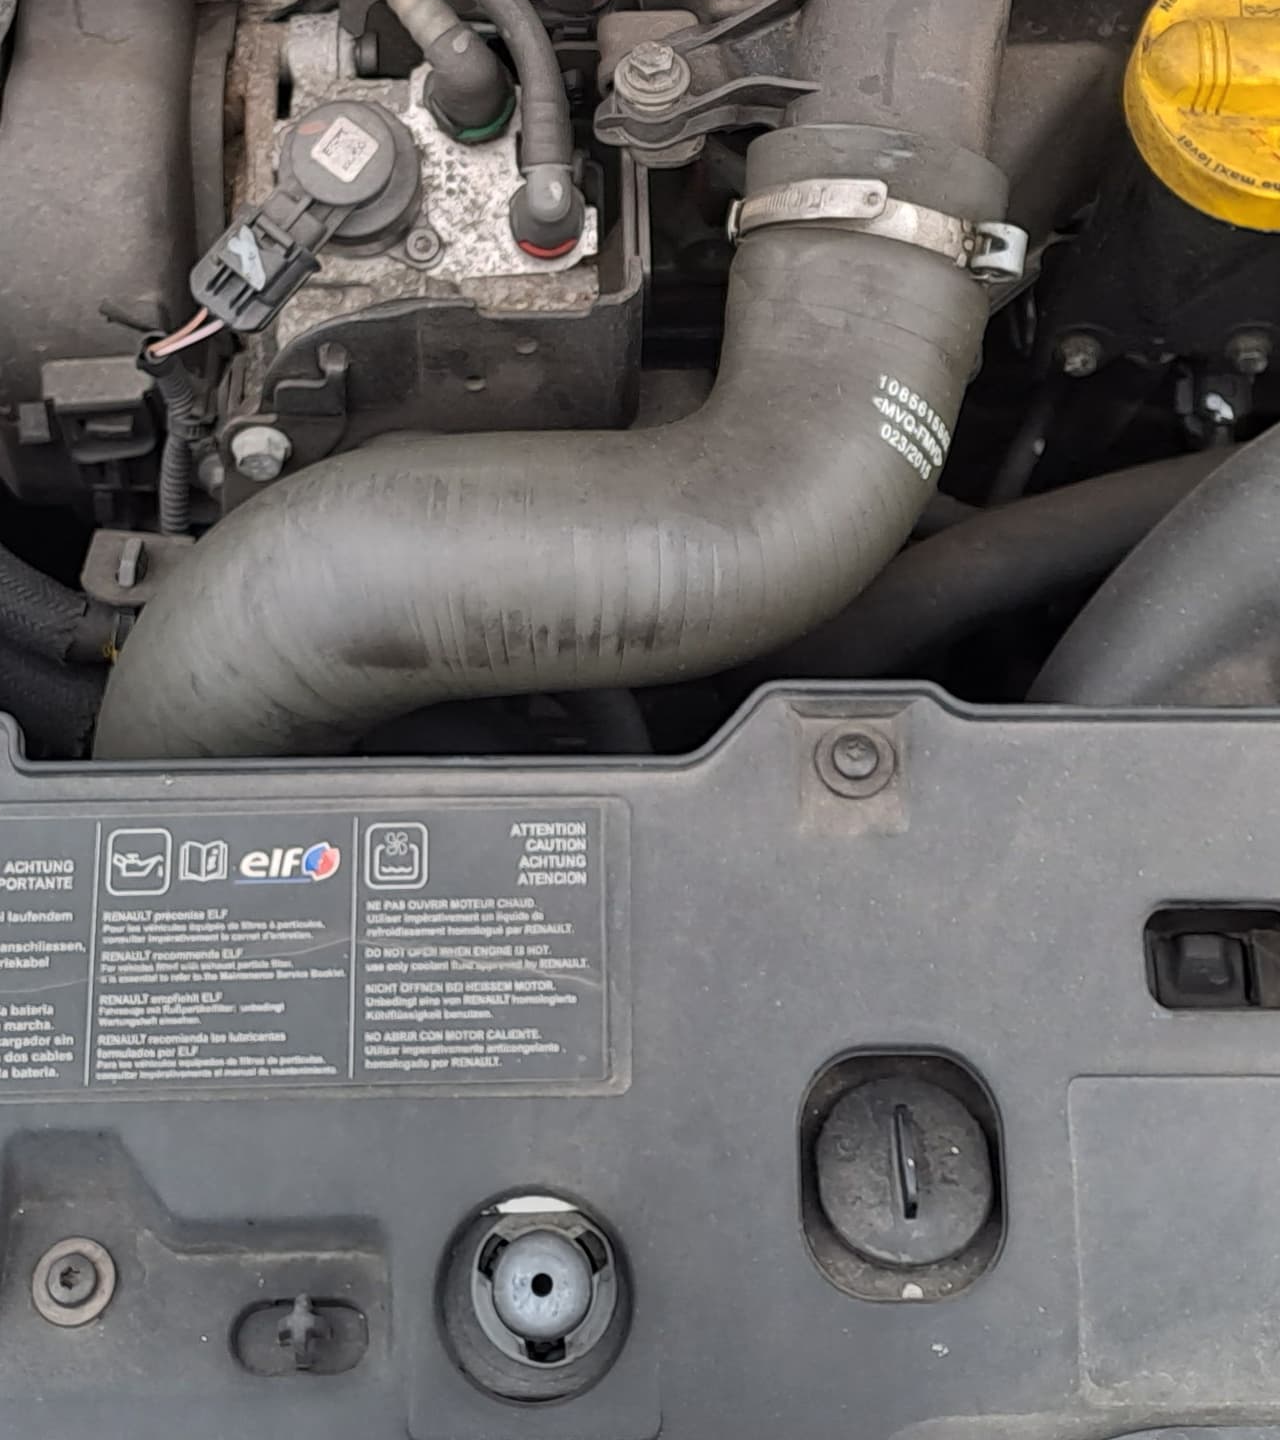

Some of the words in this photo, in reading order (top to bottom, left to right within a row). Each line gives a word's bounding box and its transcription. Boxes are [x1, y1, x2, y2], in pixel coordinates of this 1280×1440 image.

[1177, 135, 1212, 167] level
[1215, 164, 1257, 186] maxi
[510, 822, 586, 836] ATTENTION
[525, 838, 586, 852] CAUTION
[4, 860, 74, 873] ACHTUNG
[240, 847, 304, 878] elf
[519, 855, 586, 868] ACHTUNG
[517, 871, 587, 885] ATENCION
[7, 910, 73, 924] laufendem
[3, 1019, 55, 1033] marcha.
[3, 1051, 28, 1064] dos
[31, 1050, 73, 1064] cables
